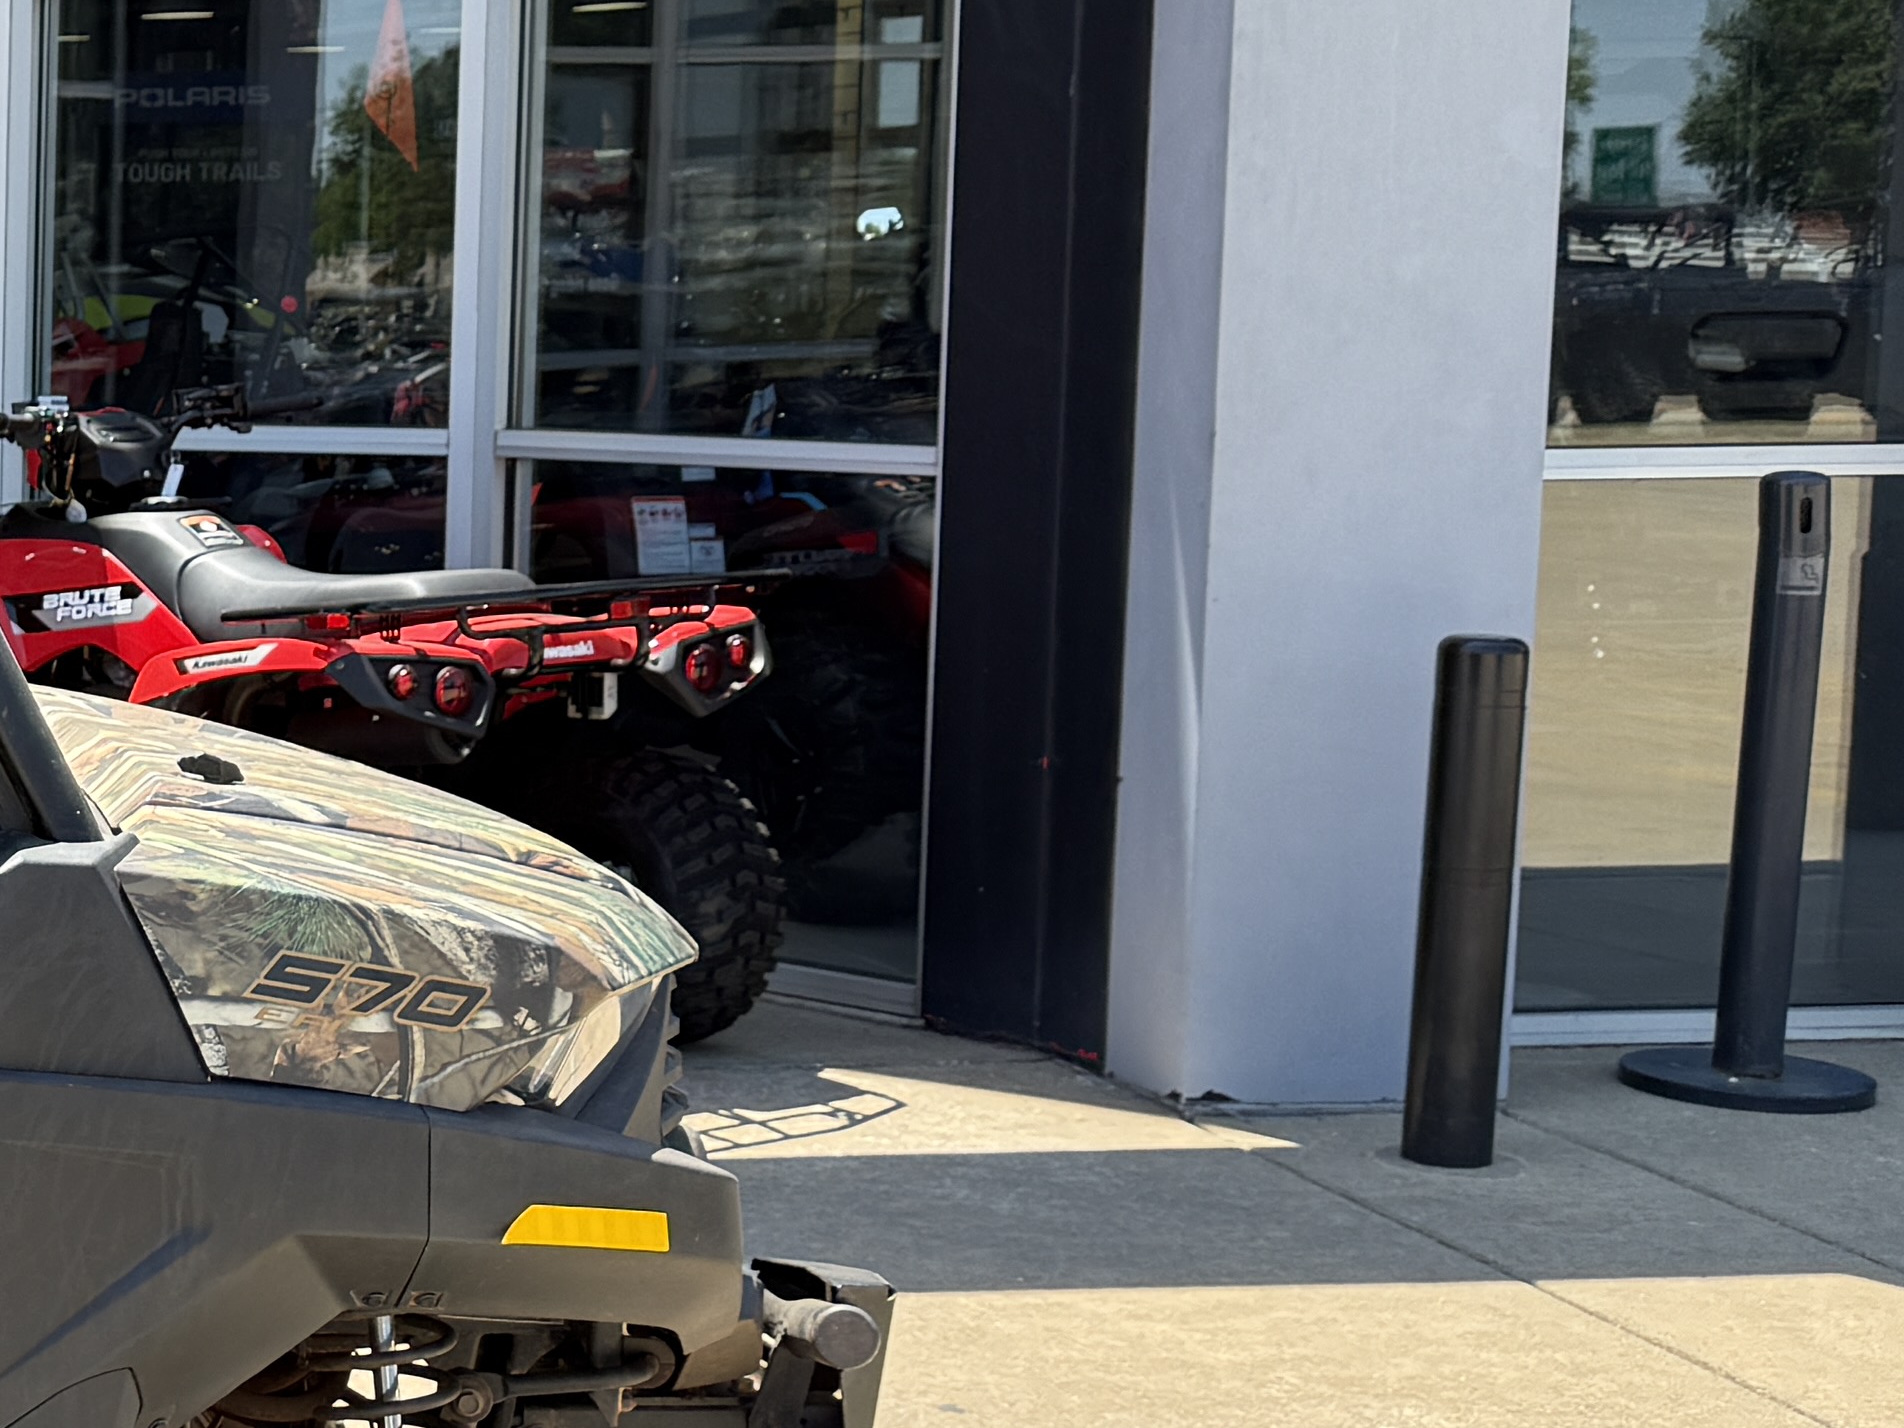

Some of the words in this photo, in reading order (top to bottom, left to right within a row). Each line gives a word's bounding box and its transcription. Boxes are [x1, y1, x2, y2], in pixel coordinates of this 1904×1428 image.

[113, 84, 272, 108] POLARIS
[113, 161, 193, 184] TOUGH
[197, 159, 284, 184] TRAILS
[42, 585, 123, 610] BRUTE
[55, 598, 134, 623] FORCE
[240, 949, 493, 1033] 570
